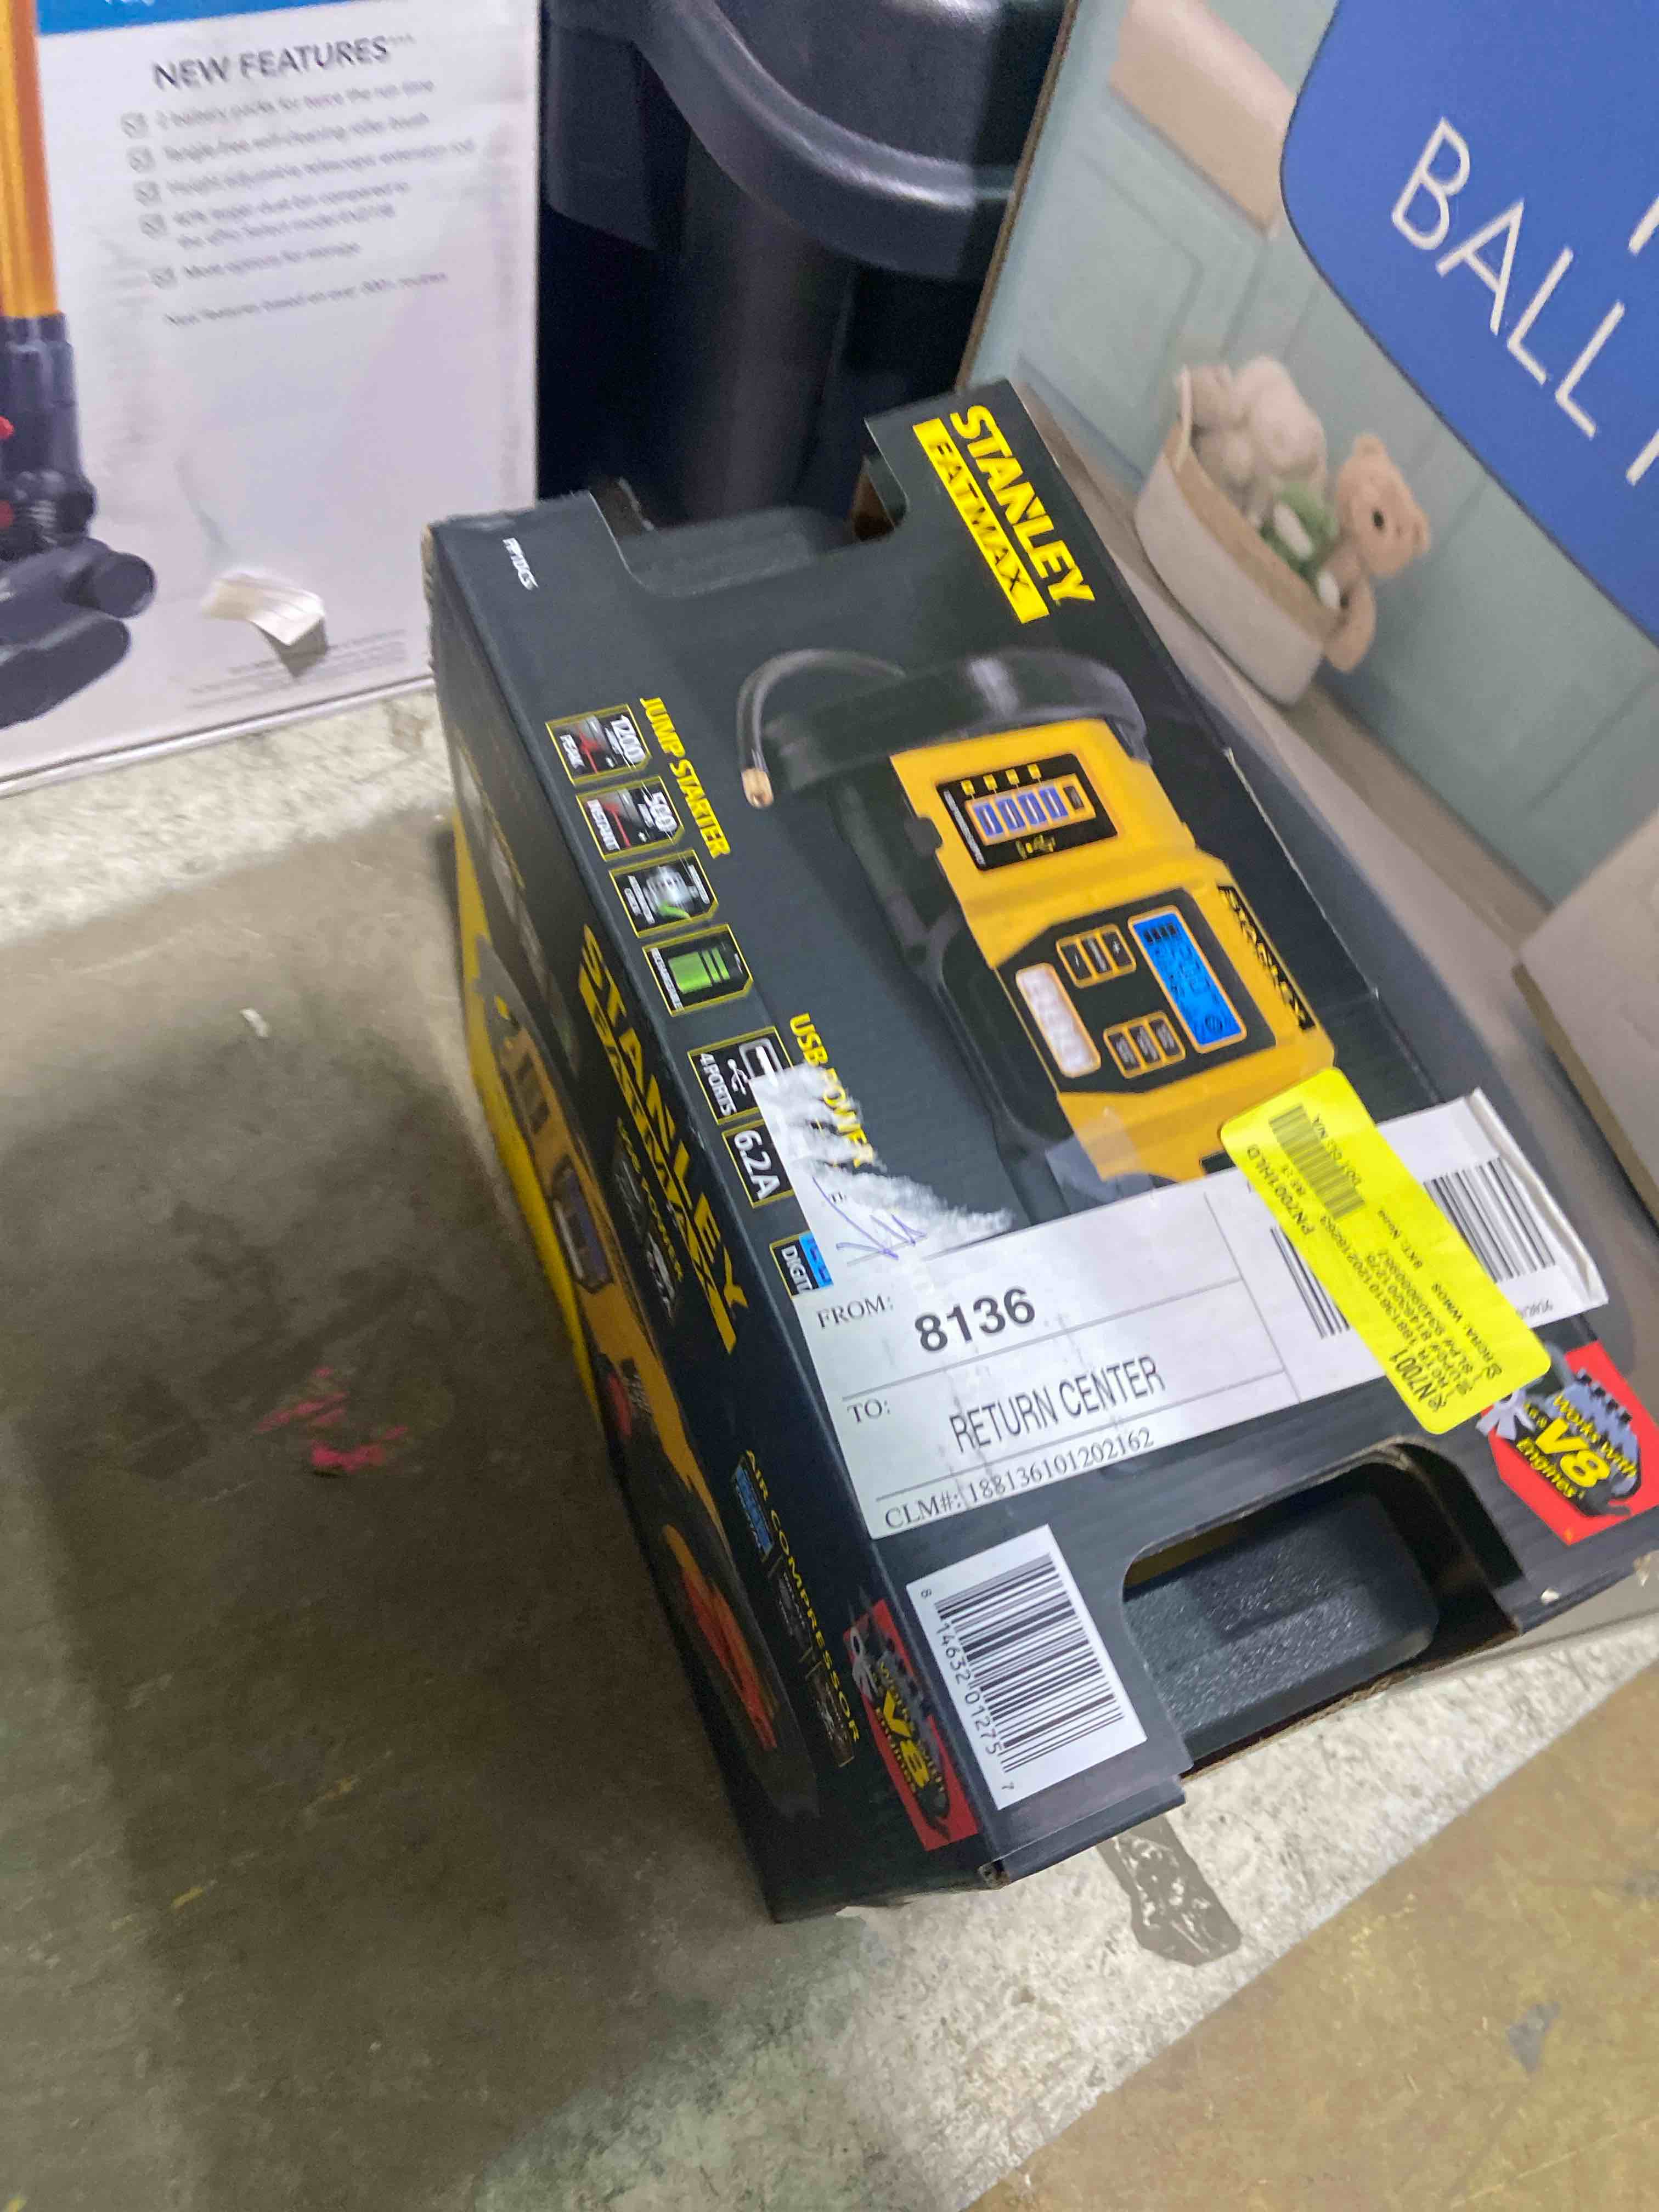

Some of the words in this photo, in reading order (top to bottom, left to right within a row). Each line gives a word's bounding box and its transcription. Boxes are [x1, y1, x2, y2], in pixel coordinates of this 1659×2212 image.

[153, 55, 228, 91] NEW
[1391, 116, 1626, 440] BALL
[950, 405, 1096, 603] STANLEY
[640, 697, 685, 759] JUMP
[669, 759, 731, 859] STARTER
[789, 1013, 828, 1066] USB
[578, 923, 749, 1309] STANLEY
[733, 1130, 783, 1200] 6.2A
[781, 1245, 813, 1294] DIGIT
[816, 1294, 894, 1329] FROM:
[914, 1285, 1036, 1352] 8136
[847, 1398, 891, 1424] TO:
[949, 1387, 1059, 1454] RETURN
[1058, 1354, 1166, 1420] CENTER
[1534, 1415, 1611, 1489] V8
[884, 1490, 963, 1530] CLM#:
[967, 1426, 1154, 1504] 188136101202162
[746, 1449, 770, 1501] AIR
[771, 1509, 860, 1742] COMPRESSOR
[884, 1688, 932, 1789] V8
[941, 1621, 972, 1687] 14632
[963, 1692, 1003, 1756] 01275
